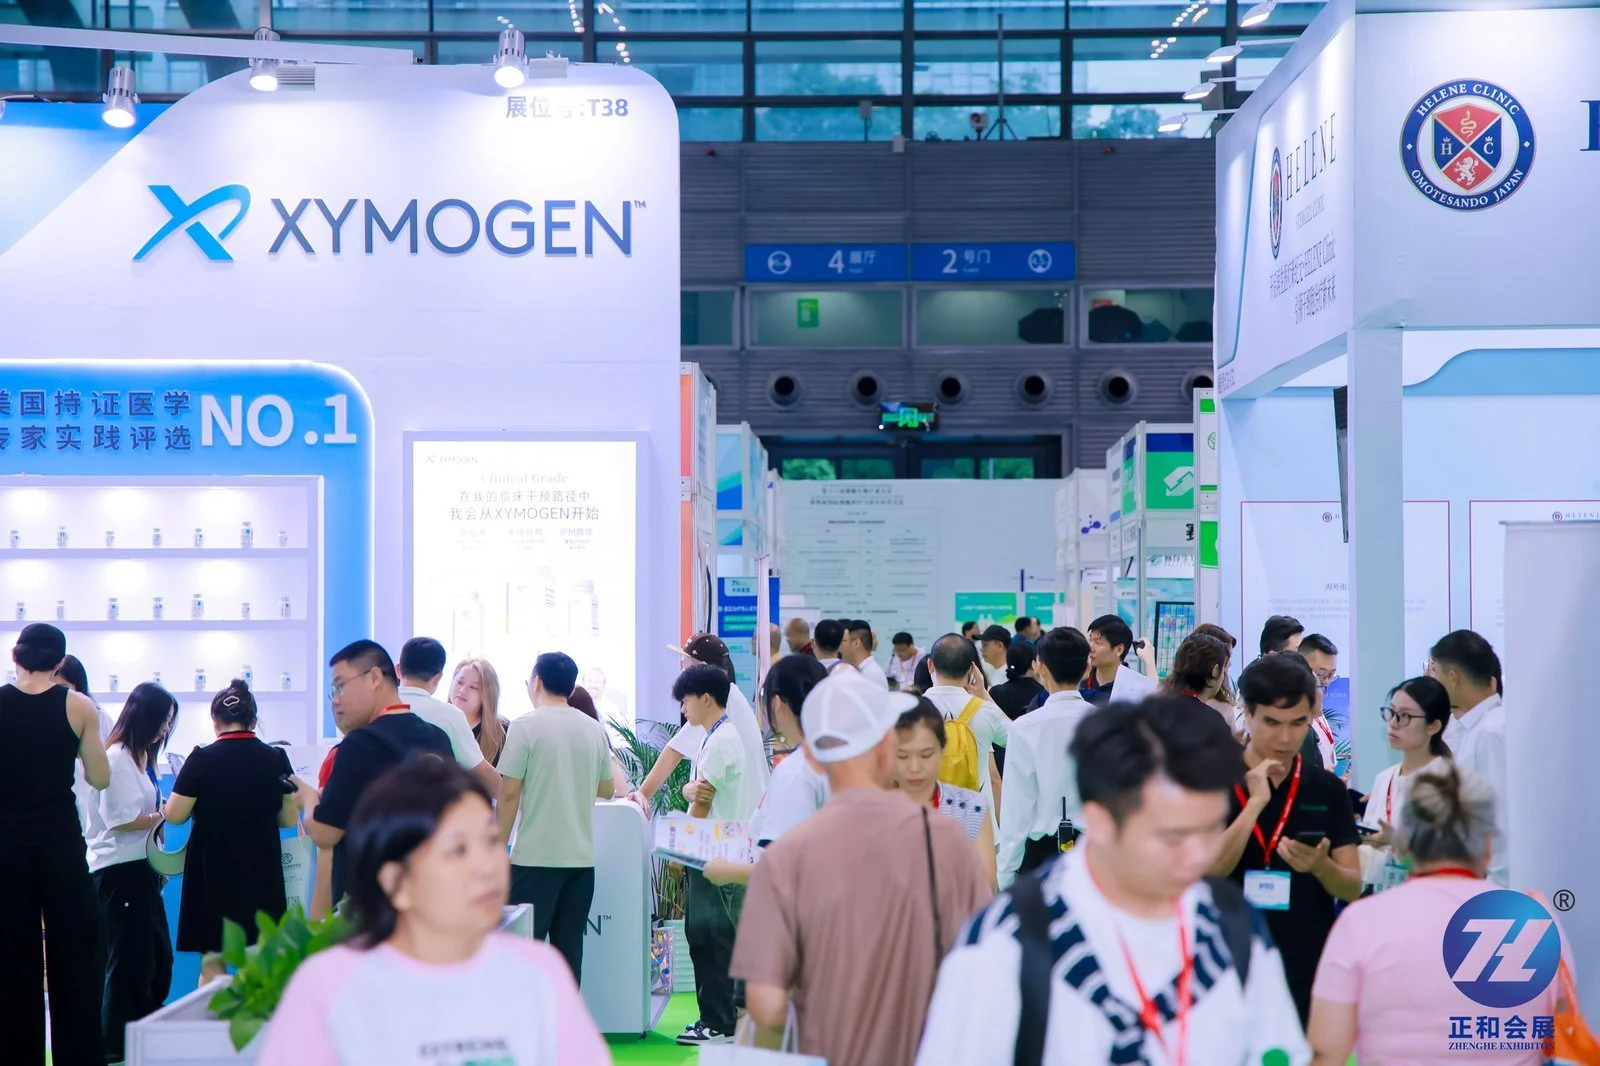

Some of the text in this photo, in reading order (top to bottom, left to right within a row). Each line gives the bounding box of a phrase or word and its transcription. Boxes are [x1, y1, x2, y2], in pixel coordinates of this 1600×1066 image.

[1416, 83, 1520, 117] HELENE CLINIC
[1286, 113, 1336, 201] HELENE
[1440, 143, 1453, 155] H
[1483, 142, 1494, 155] C
[1411, 169, 1524, 208] OMOTESANDO JAPAN
[828, 249, 844, 274] 4
[942, 249, 957, 274] 2
[0, 425, 192, 451] 家实践评选
[531, 472, 569, 485] Grade
[459, 490, 591, 503] 在我的临床干预路径中
[449, 507, 600, 521] 我会从XYMOGEN开始
